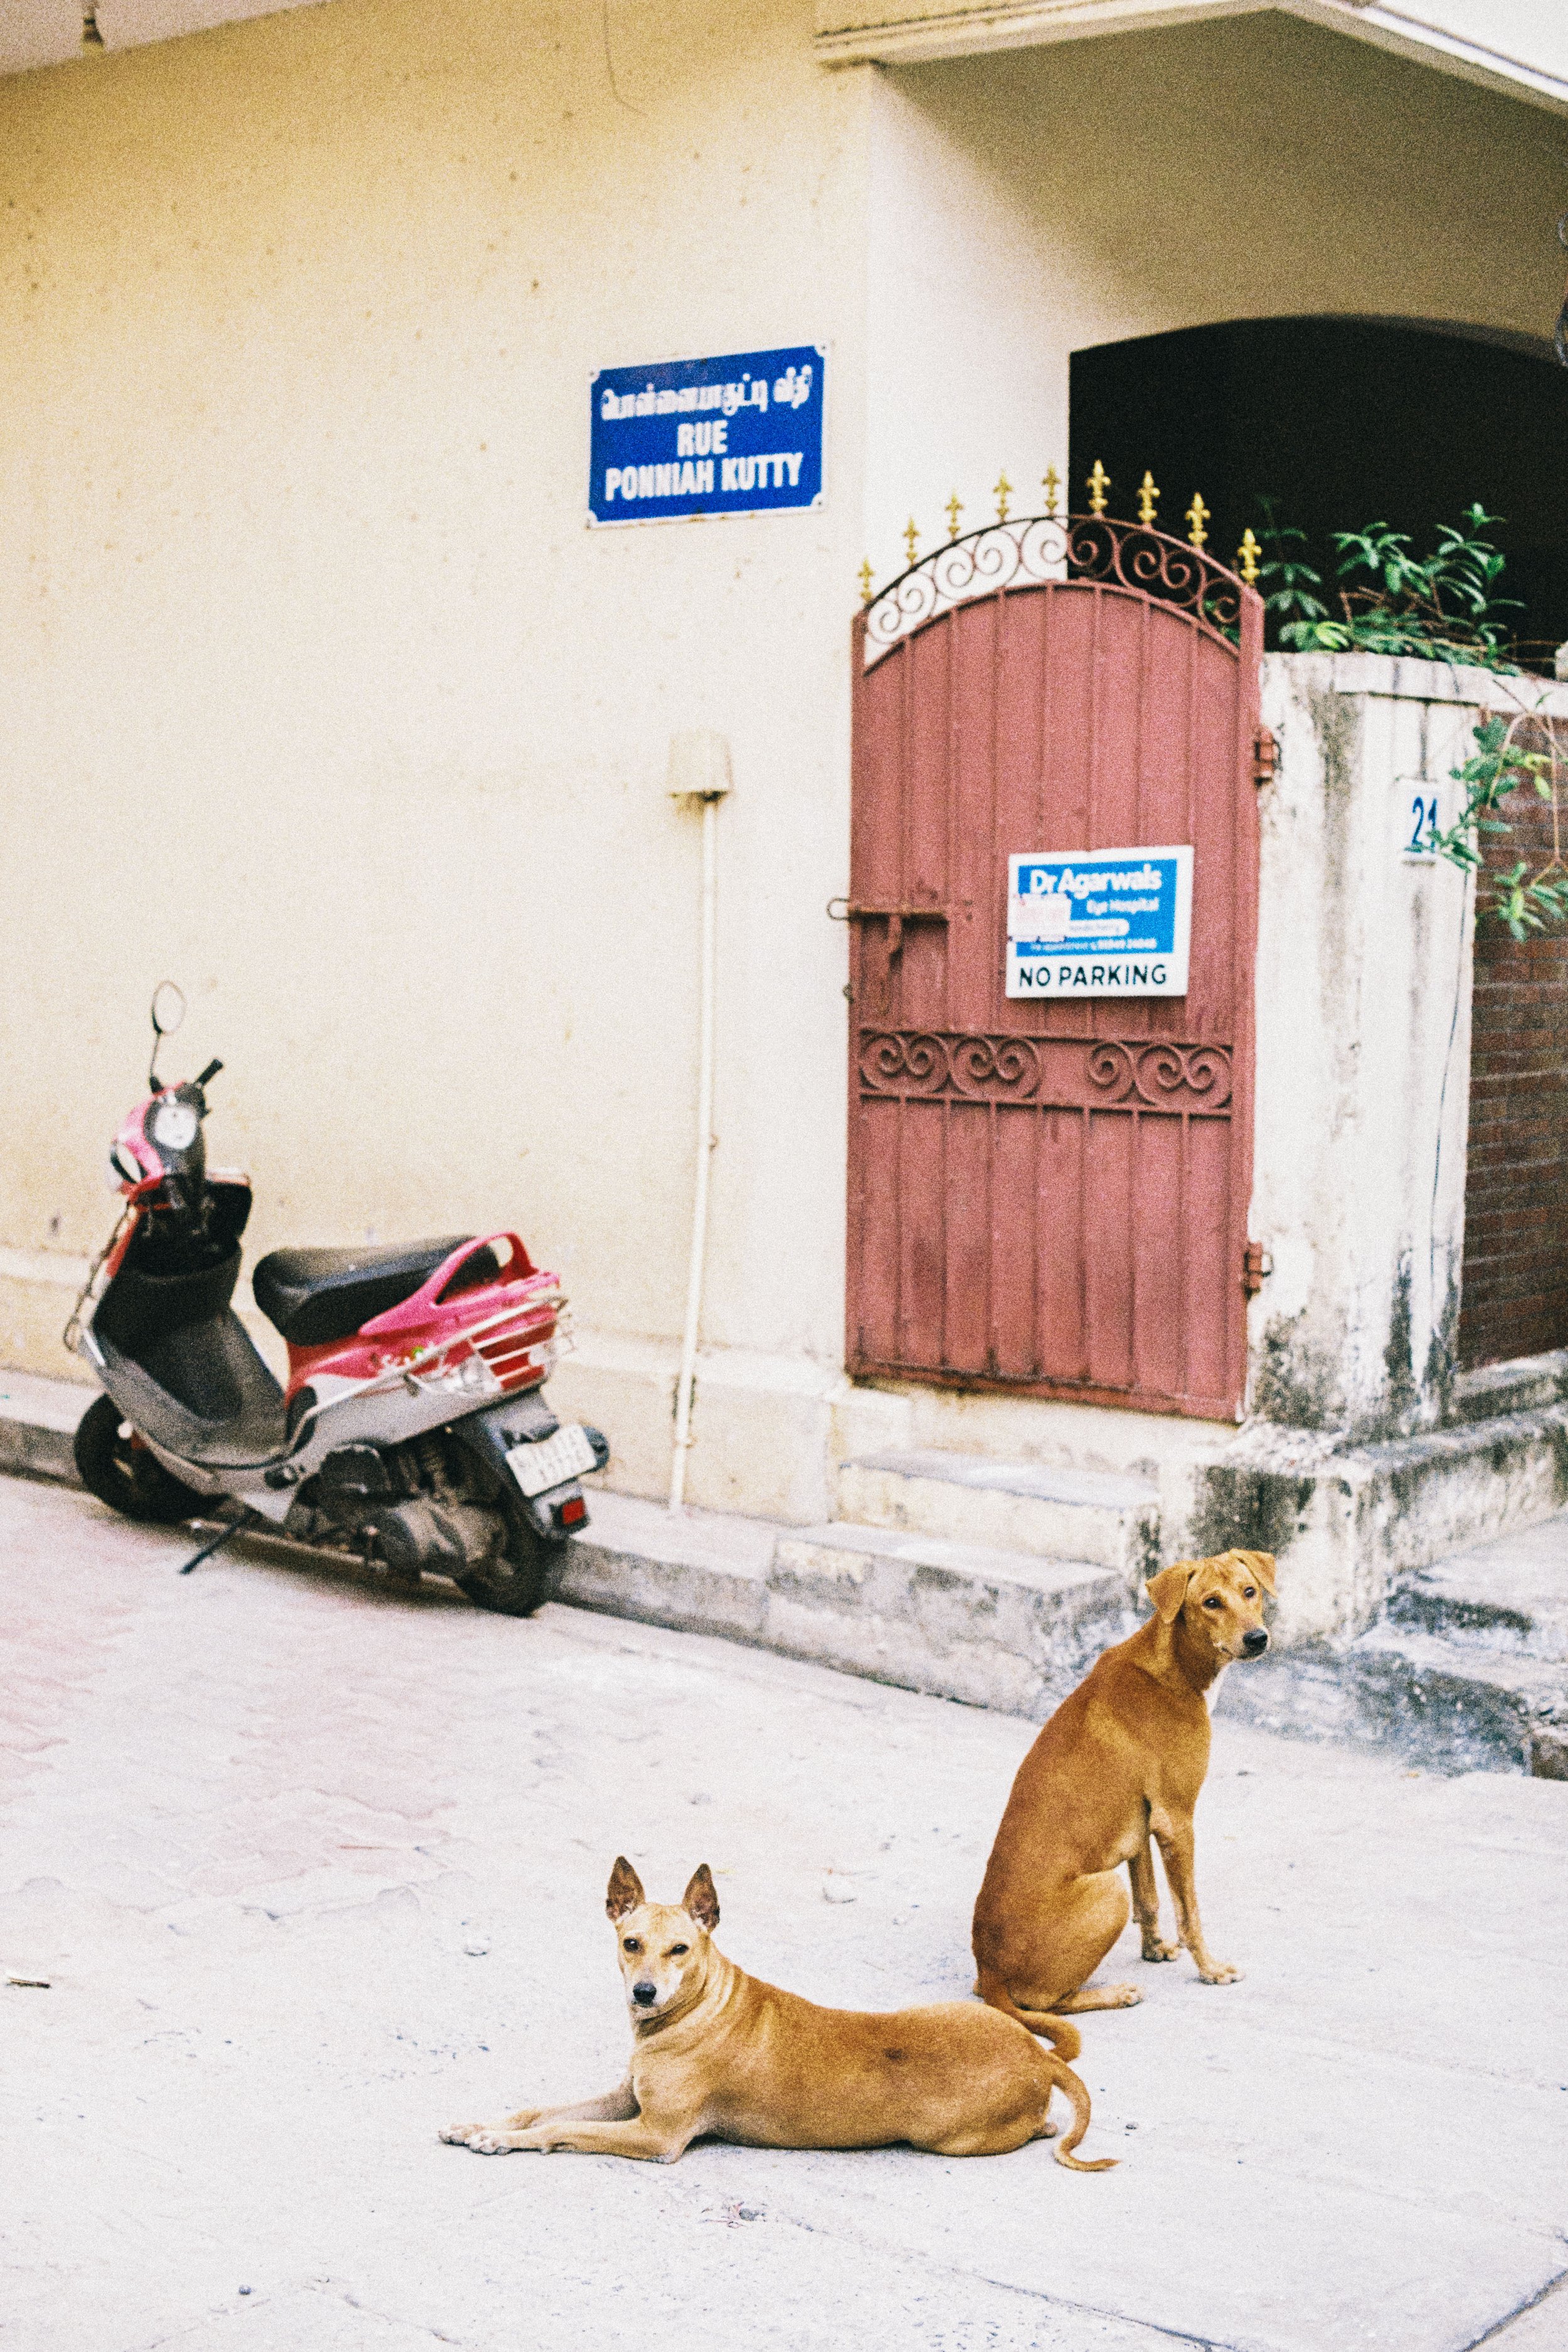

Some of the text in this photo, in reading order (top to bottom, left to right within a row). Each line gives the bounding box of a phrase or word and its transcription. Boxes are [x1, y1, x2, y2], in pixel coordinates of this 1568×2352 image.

[677, 420, 728, 457] RUE
[605, 452, 803, 501] PONNIAH KUTTY
[1411, 796, 1437, 850] 21
[1019, 964, 1167, 987] NO PARKING
